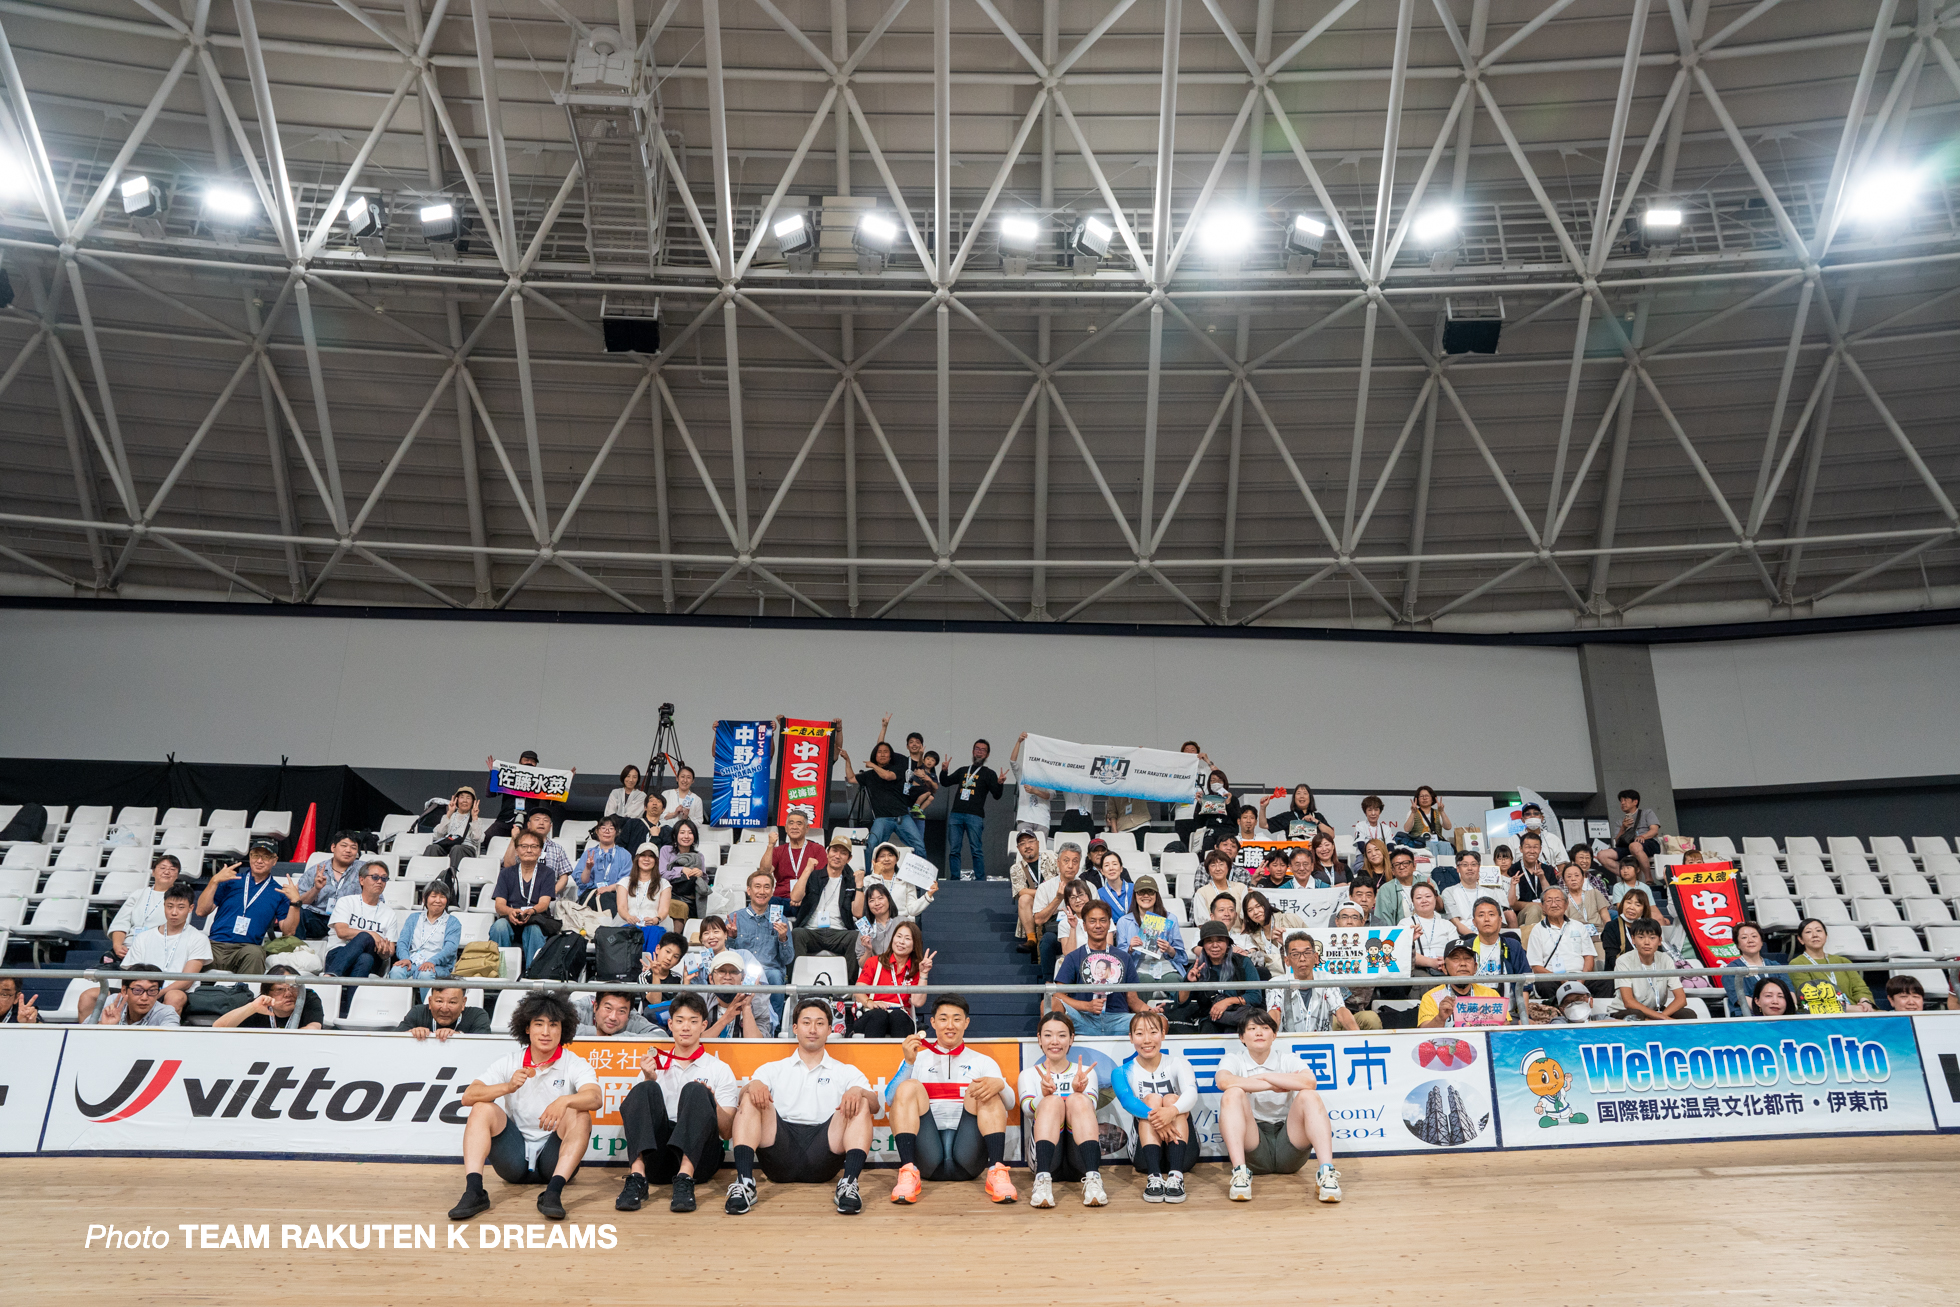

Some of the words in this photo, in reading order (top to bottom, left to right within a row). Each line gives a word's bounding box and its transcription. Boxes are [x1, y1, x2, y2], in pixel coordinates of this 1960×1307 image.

[1041, 758, 1062, 767] RAKUTEN
[720, 763, 745, 776] SHINJI
[731, 765, 763, 779] NAKANO
[1147, 770, 1168, 778] RAKUTEN
[498, 768, 567, 794] 佐藤水菜
[719, 818, 741, 826] IWATE
[742, 818, 761, 826] 121th
[348, 913, 383, 934] FOTL
[1325, 950, 1364, 958] DREAMS
[1801, 981, 1836, 1002] 全力
[1456, 1002, 1504, 1015] 佐藤水菜
[1579, 1041, 1779, 1093] Welcome
[1780, 1039, 1828, 1085] to
[1828, 1034, 1891, 1083] Ito
[1597, 1089, 1889, 1124] 国際観光温泉文化都市・伊東市
